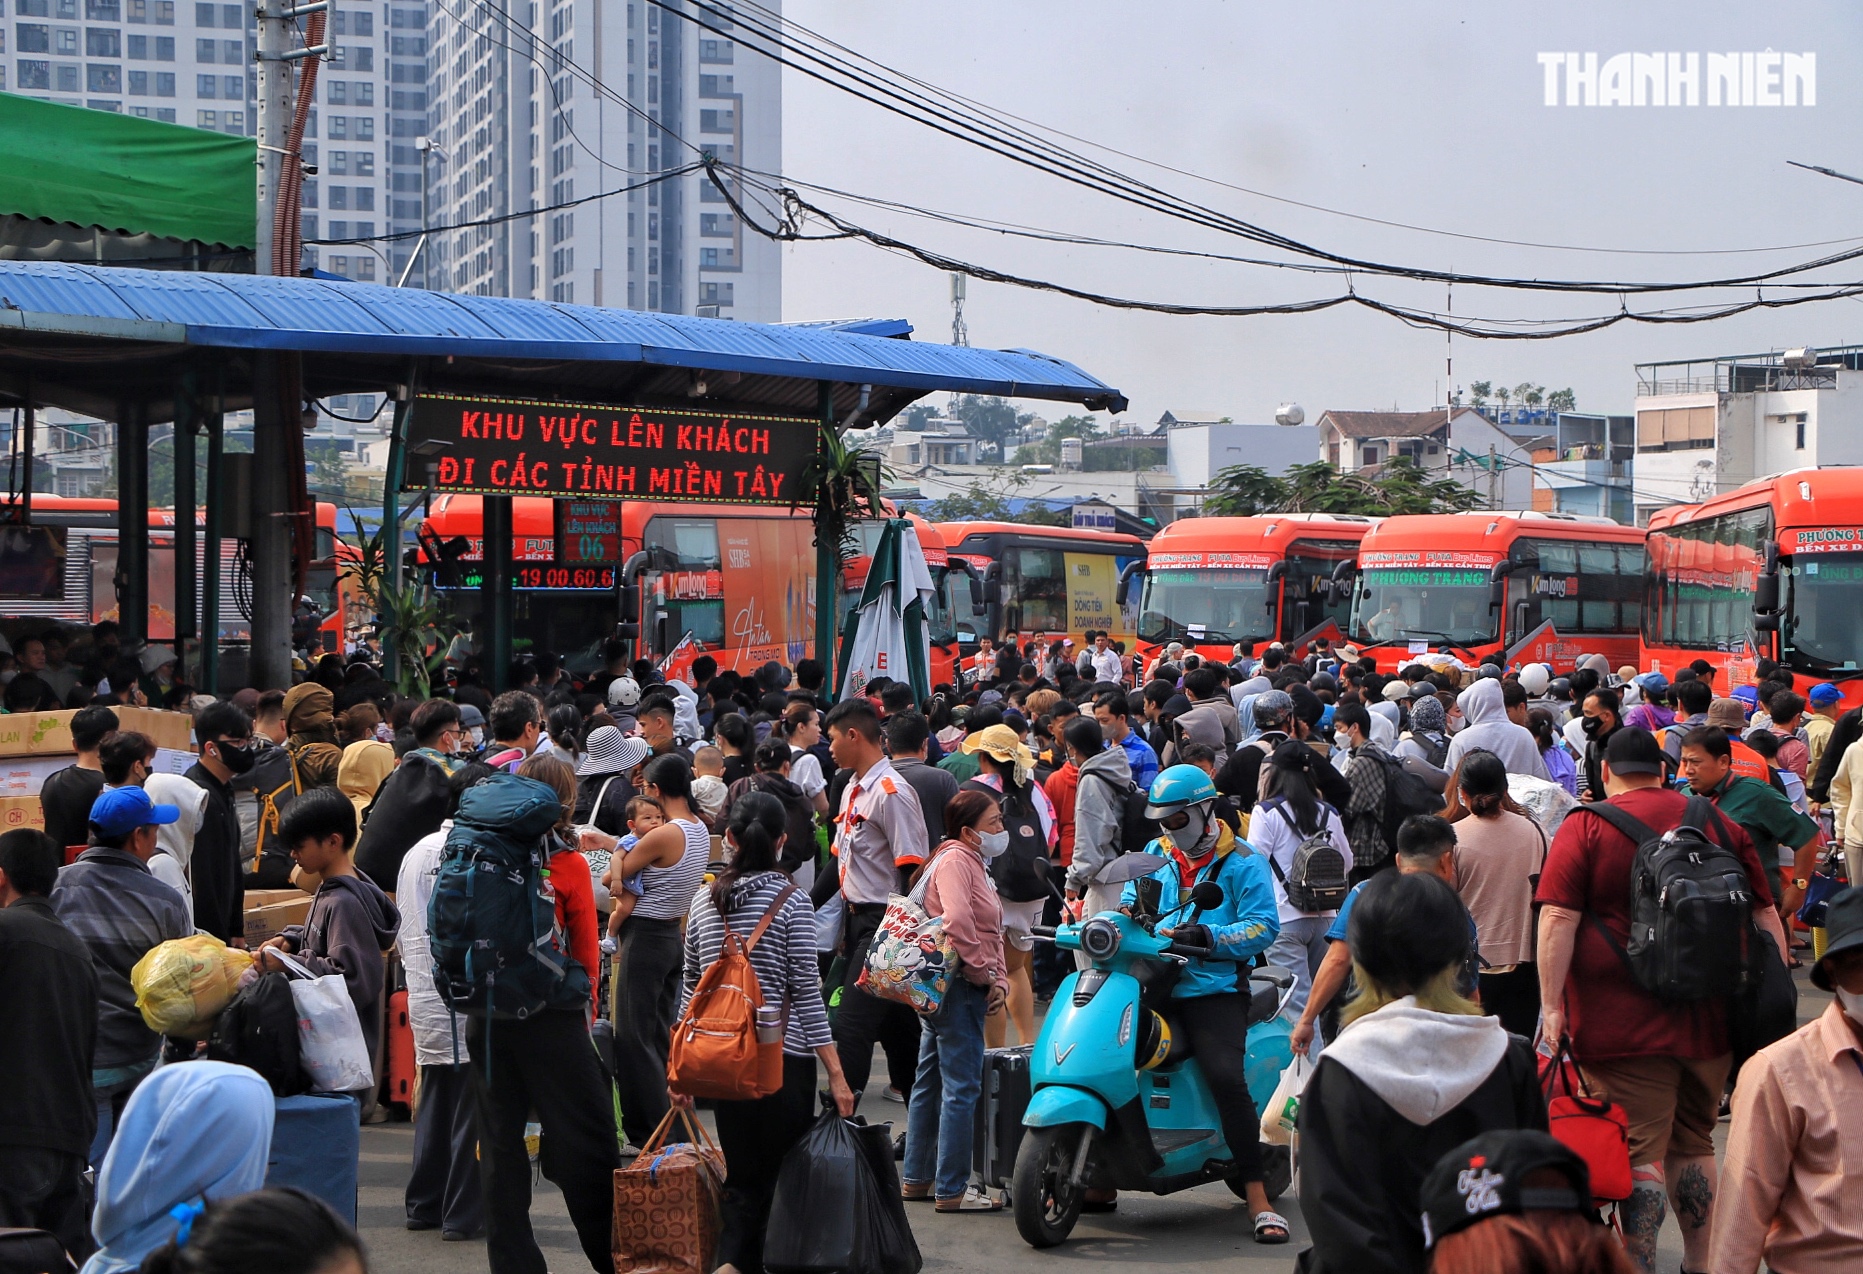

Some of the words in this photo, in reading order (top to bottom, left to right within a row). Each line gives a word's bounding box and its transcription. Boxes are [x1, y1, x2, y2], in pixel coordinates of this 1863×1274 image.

[461, 411, 525, 441] KHU
[539, 412, 598, 449] VỰC
[611, 413, 664, 449] LÊN
[677, 419, 770, 455] KHÁCH
[438, 456, 475, 485] ĐI
[490, 452, 549, 488] CÁC
[562, 455, 636, 492] TỈNH
[649, 460, 722, 495] MIỀN
[734, 464, 785, 498] TÂY
[1797, 528, 1855, 544] PHƯƠNG
[579, 533, 605, 560] 06
[1795, 543, 1825, 553] BẾN
[1828, 544, 1849, 552] XE
[525, 550, 544, 560] BẾN
[1426, 553, 1452, 562] FUTA
[1453, 553, 1469, 562] Bus
[1470, 553, 1494, 563] Lines
[1425, 560, 1441, 568] BẾN
[521, 568, 542, 587] 19
[1370, 569, 1430, 585] PHƯƠNG
[1432, 571, 1485, 585] TRANG
[9, 811, 22, 823] CH
[585, 851, 612, 862] ATCH
